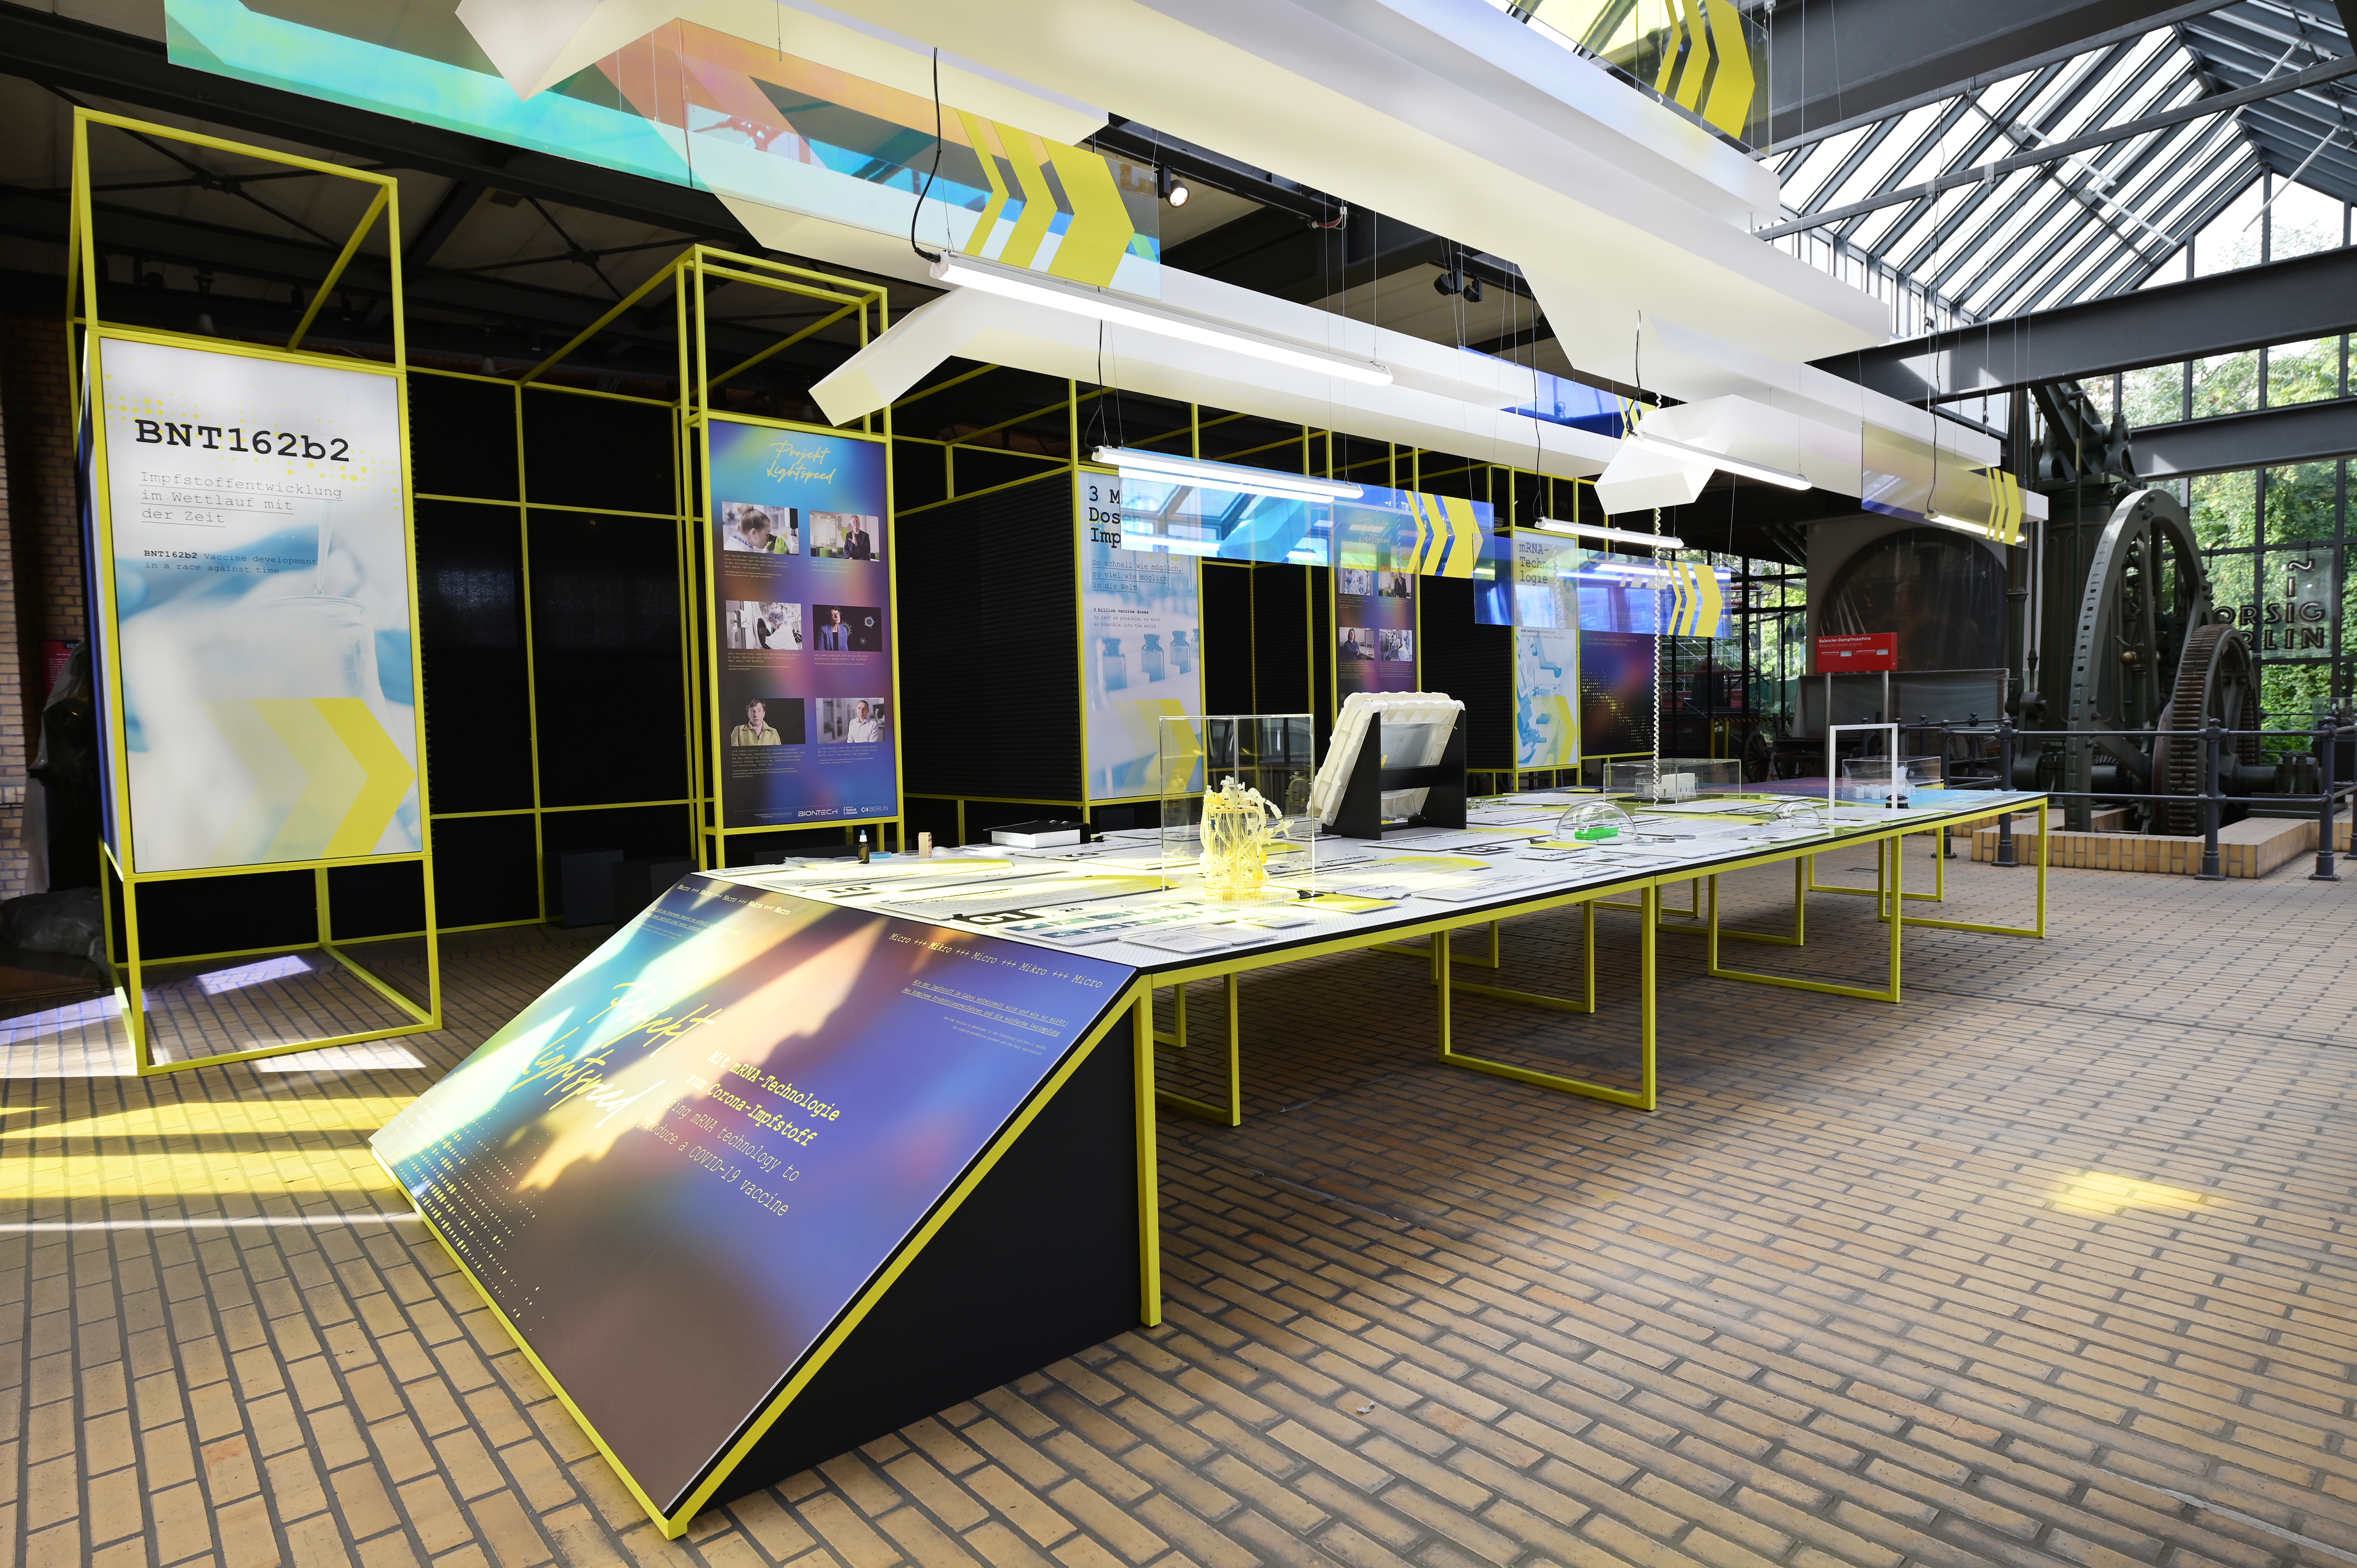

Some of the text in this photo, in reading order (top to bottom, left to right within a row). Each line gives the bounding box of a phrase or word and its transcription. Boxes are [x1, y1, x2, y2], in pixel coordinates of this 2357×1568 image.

[135, 419, 349, 461] BNT162b2
[769, 441, 831, 465] Projekt
[766, 459, 836, 484] Lightspeed
[140, 471, 341, 499] Impfstoffentwicklung
[1089, 485, 1098, 501] 3
[142, 489, 293, 510] im Wettlauf mit
[142, 508, 225, 523] der Zeit
[1360, 517, 1389, 533] Projekt
[1359, 531, 1391, 546] Lightspeed
[1519, 542, 1549, 555] mRNA-
[144, 550, 198, 559] BNT162b2
[252, 556, 317, 565] development
[1151, 564, 1181, 573] möglich,
[1520, 570, 1548, 586] logie
[747, 900, 763, 909] Makro
[773, 905, 791, 915] Macro
[889, 932, 911, 944] Micro
[928, 941, 952, 953] Mikro
[971, 951, 997, 964] Micro
[1019, 962, 1048, 976] Mikro
[1071, 974, 1103, 988] Micro
[587, 977, 722, 1058] Projekt
[912, 989, 932, 999] komplexe
[932, 995, 982, 1014] Produktionsverfahren
[1004, 1016, 1028, 1027] einfache
[1030, 1023, 1061, 1037] Verimpfung
[931, 984, 955, 994] Impfstoff
[976, 997, 1004, 1008] entwickelt
[1049, 1016, 1069, 1026] wirkt:
[508, 1026, 667, 1129] Lightspeed
[707, 1050, 841, 1122] Mit mRNA-Technologie
[685, 1074, 818, 1147] zum Corona-Impfstoff
[662, 1094, 800, 1182] Using mRNA technology to
[636, 1117, 789, 1217] produce a COVID-19 vaccine
